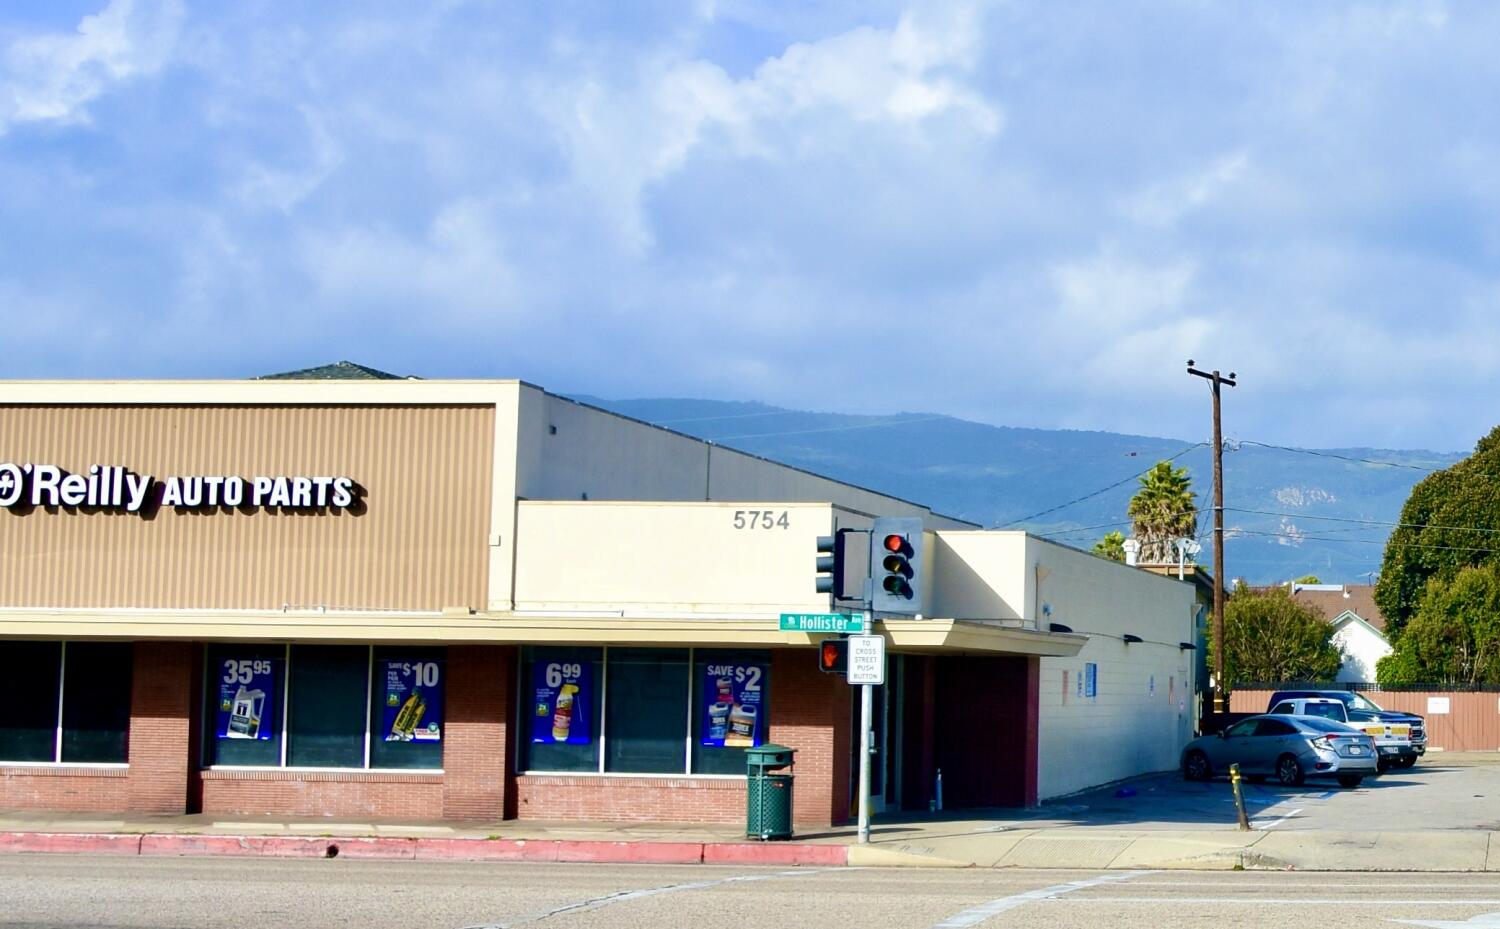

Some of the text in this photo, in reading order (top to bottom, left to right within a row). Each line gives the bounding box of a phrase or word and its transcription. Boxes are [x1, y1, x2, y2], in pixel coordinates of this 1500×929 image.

[161, 476, 242, 506] AUTO
[252, 476, 352, 507] PARTS
[733, 510, 790, 530] 5754
[799, 615, 849, 630] Hollister
[402, 662, 439, 687] $10
[707, 665, 762, 691] SAVE $2
